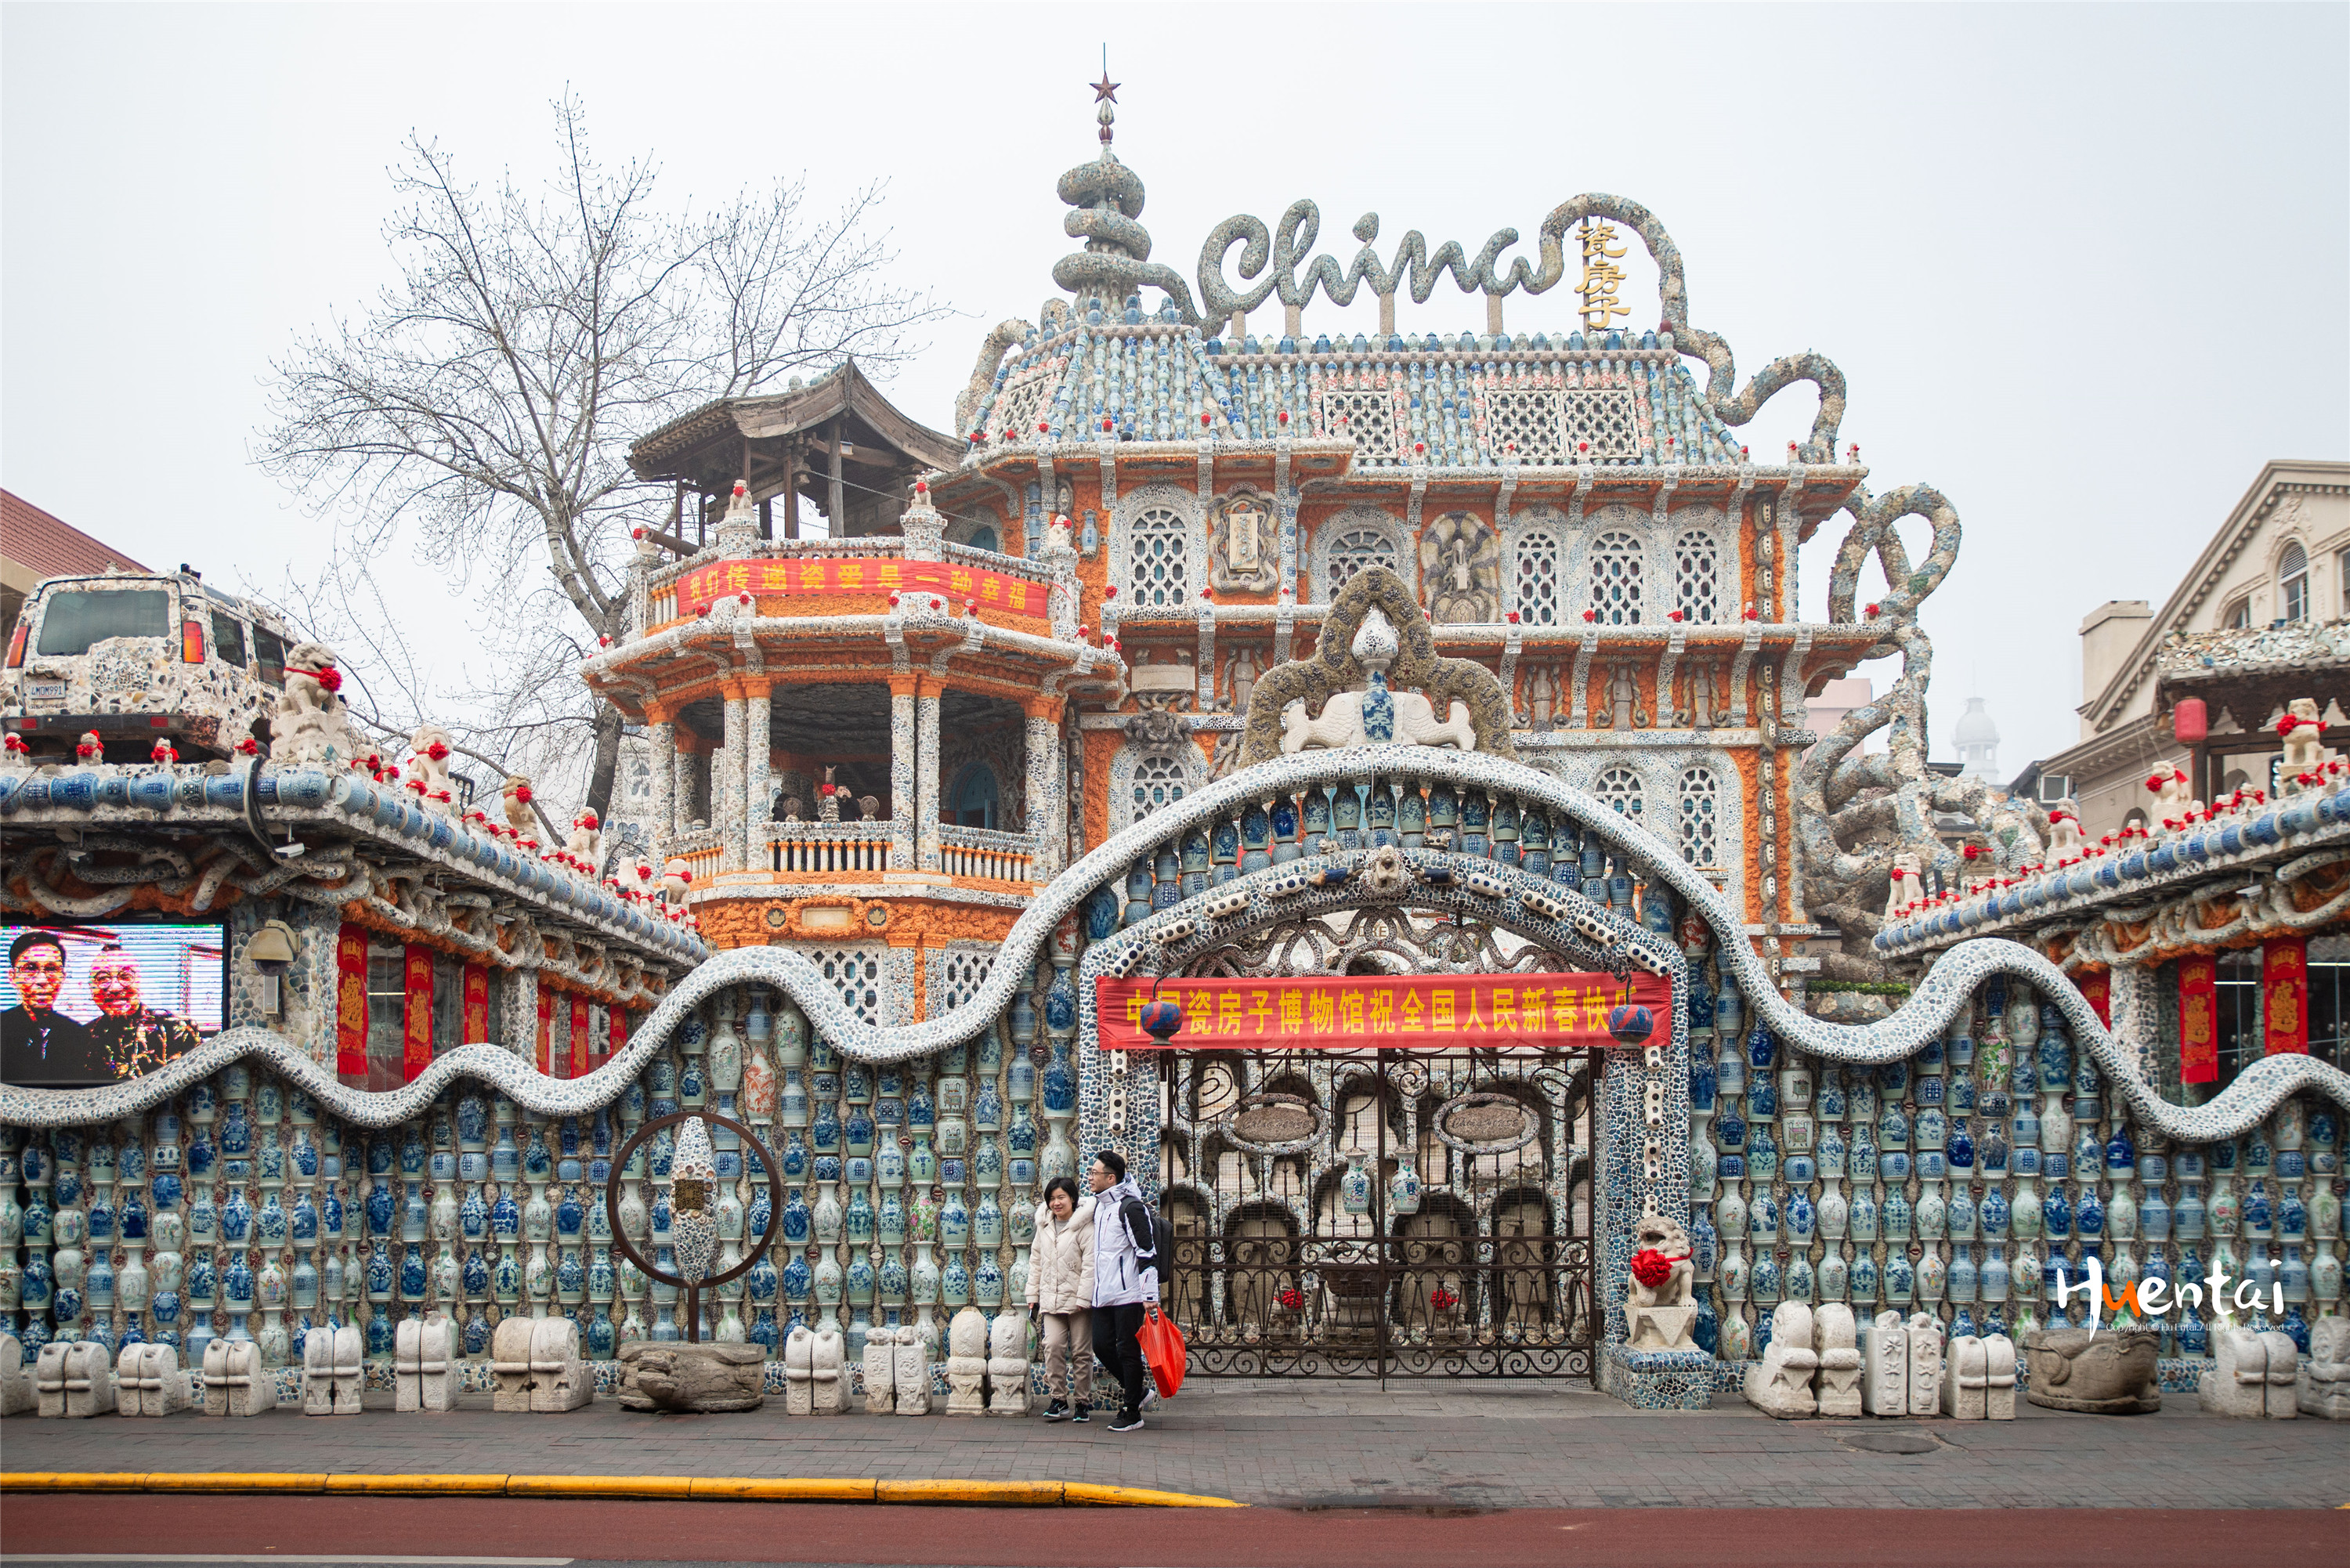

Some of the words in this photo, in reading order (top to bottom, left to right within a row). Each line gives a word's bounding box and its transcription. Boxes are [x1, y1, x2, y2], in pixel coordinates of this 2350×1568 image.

[1197, 198, 1559, 315] China
[1574, 222, 1631, 328] 瓷房子
[689, 563, 1028, 610] 我们传递瓷爱是一种幸福
